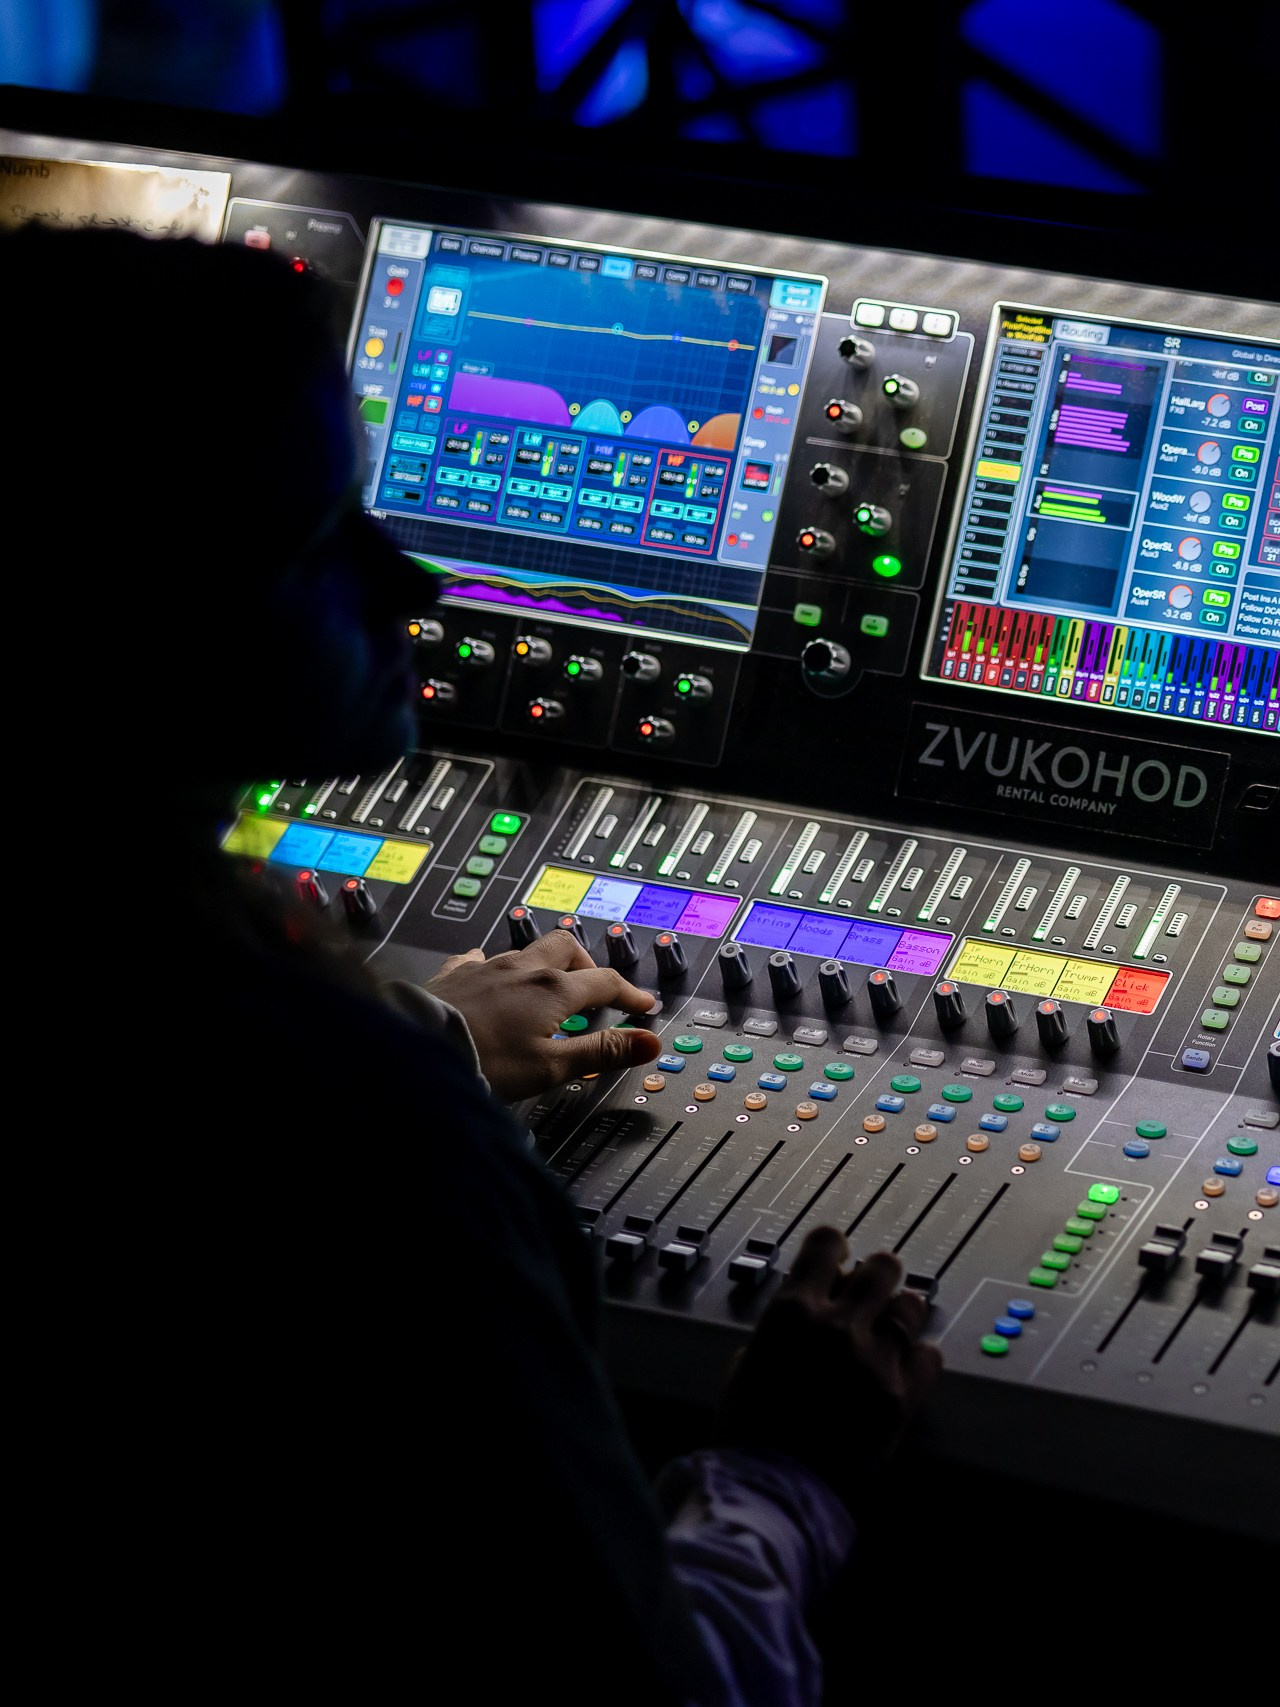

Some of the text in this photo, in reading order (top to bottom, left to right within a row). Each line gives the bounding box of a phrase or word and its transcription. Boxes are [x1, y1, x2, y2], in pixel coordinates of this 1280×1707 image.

[1060, 324, 1104, 340] Routing
[1164, 337, 1181, 349] SR
[1254, 371, 1268, 382] On
[1245, 401, 1265, 412] Post
[1244, 420, 1258, 431] On
[1238, 449, 1254, 460] Pre
[1209, 467, 1221, 477] dB
[1235, 468, 1249, 479] On
[1228, 497, 1244, 508] Pre
[1225, 516, 1239, 527] On
[1142, 538, 1174, 553] OperSL
[1218, 544, 1234, 556] Pre
[1140, 549, 1159, 559] Aux3
[1215, 564, 1229, 575] On
[1132, 586, 1166, 601] OperSR
[1208, 592, 1225, 604] Pre
[1243, 592, 1260, 602] Post
[1260, 594, 1272, 604] Ins
[1271, 596, 1279, 604] A
[1130, 596, 1149, 606] Aux4
[1240, 602, 1263, 613] Follow
[1163, 608, 1192, 621] -3.2 dB
[1205, 612, 1220, 623] On
[1238, 613, 1261, 624] Follow
[1261, 616, 1273, 626] Ch
[1236, 624, 1259, 635] Follow
[1260, 626, 1272, 636] Ch
[918, 722, 1207, 808] ZVUKOHOD
[996, 784, 1046, 804] RENTAL
[1049, 793, 1118, 816] COMPANY
[686, 904, 699, 912] SL
[848, 931, 883, 945] Brass
[898, 940, 940, 955] Basson
[960, 953, 1004, 967] FrHorn
[955, 967, 977, 976] Gain
[1011, 960, 1055, 975] FrHorn
[1006, 975, 1028, 985] Gain
[1114, 978, 1150, 992] Click
[1057, 984, 1097, 997] Gain dB
[1197, 1033, 1216, 1042] Rotary
[1192, 1039, 1216, 1048] Function
[1185, 1054, 1203, 1063] Sends
